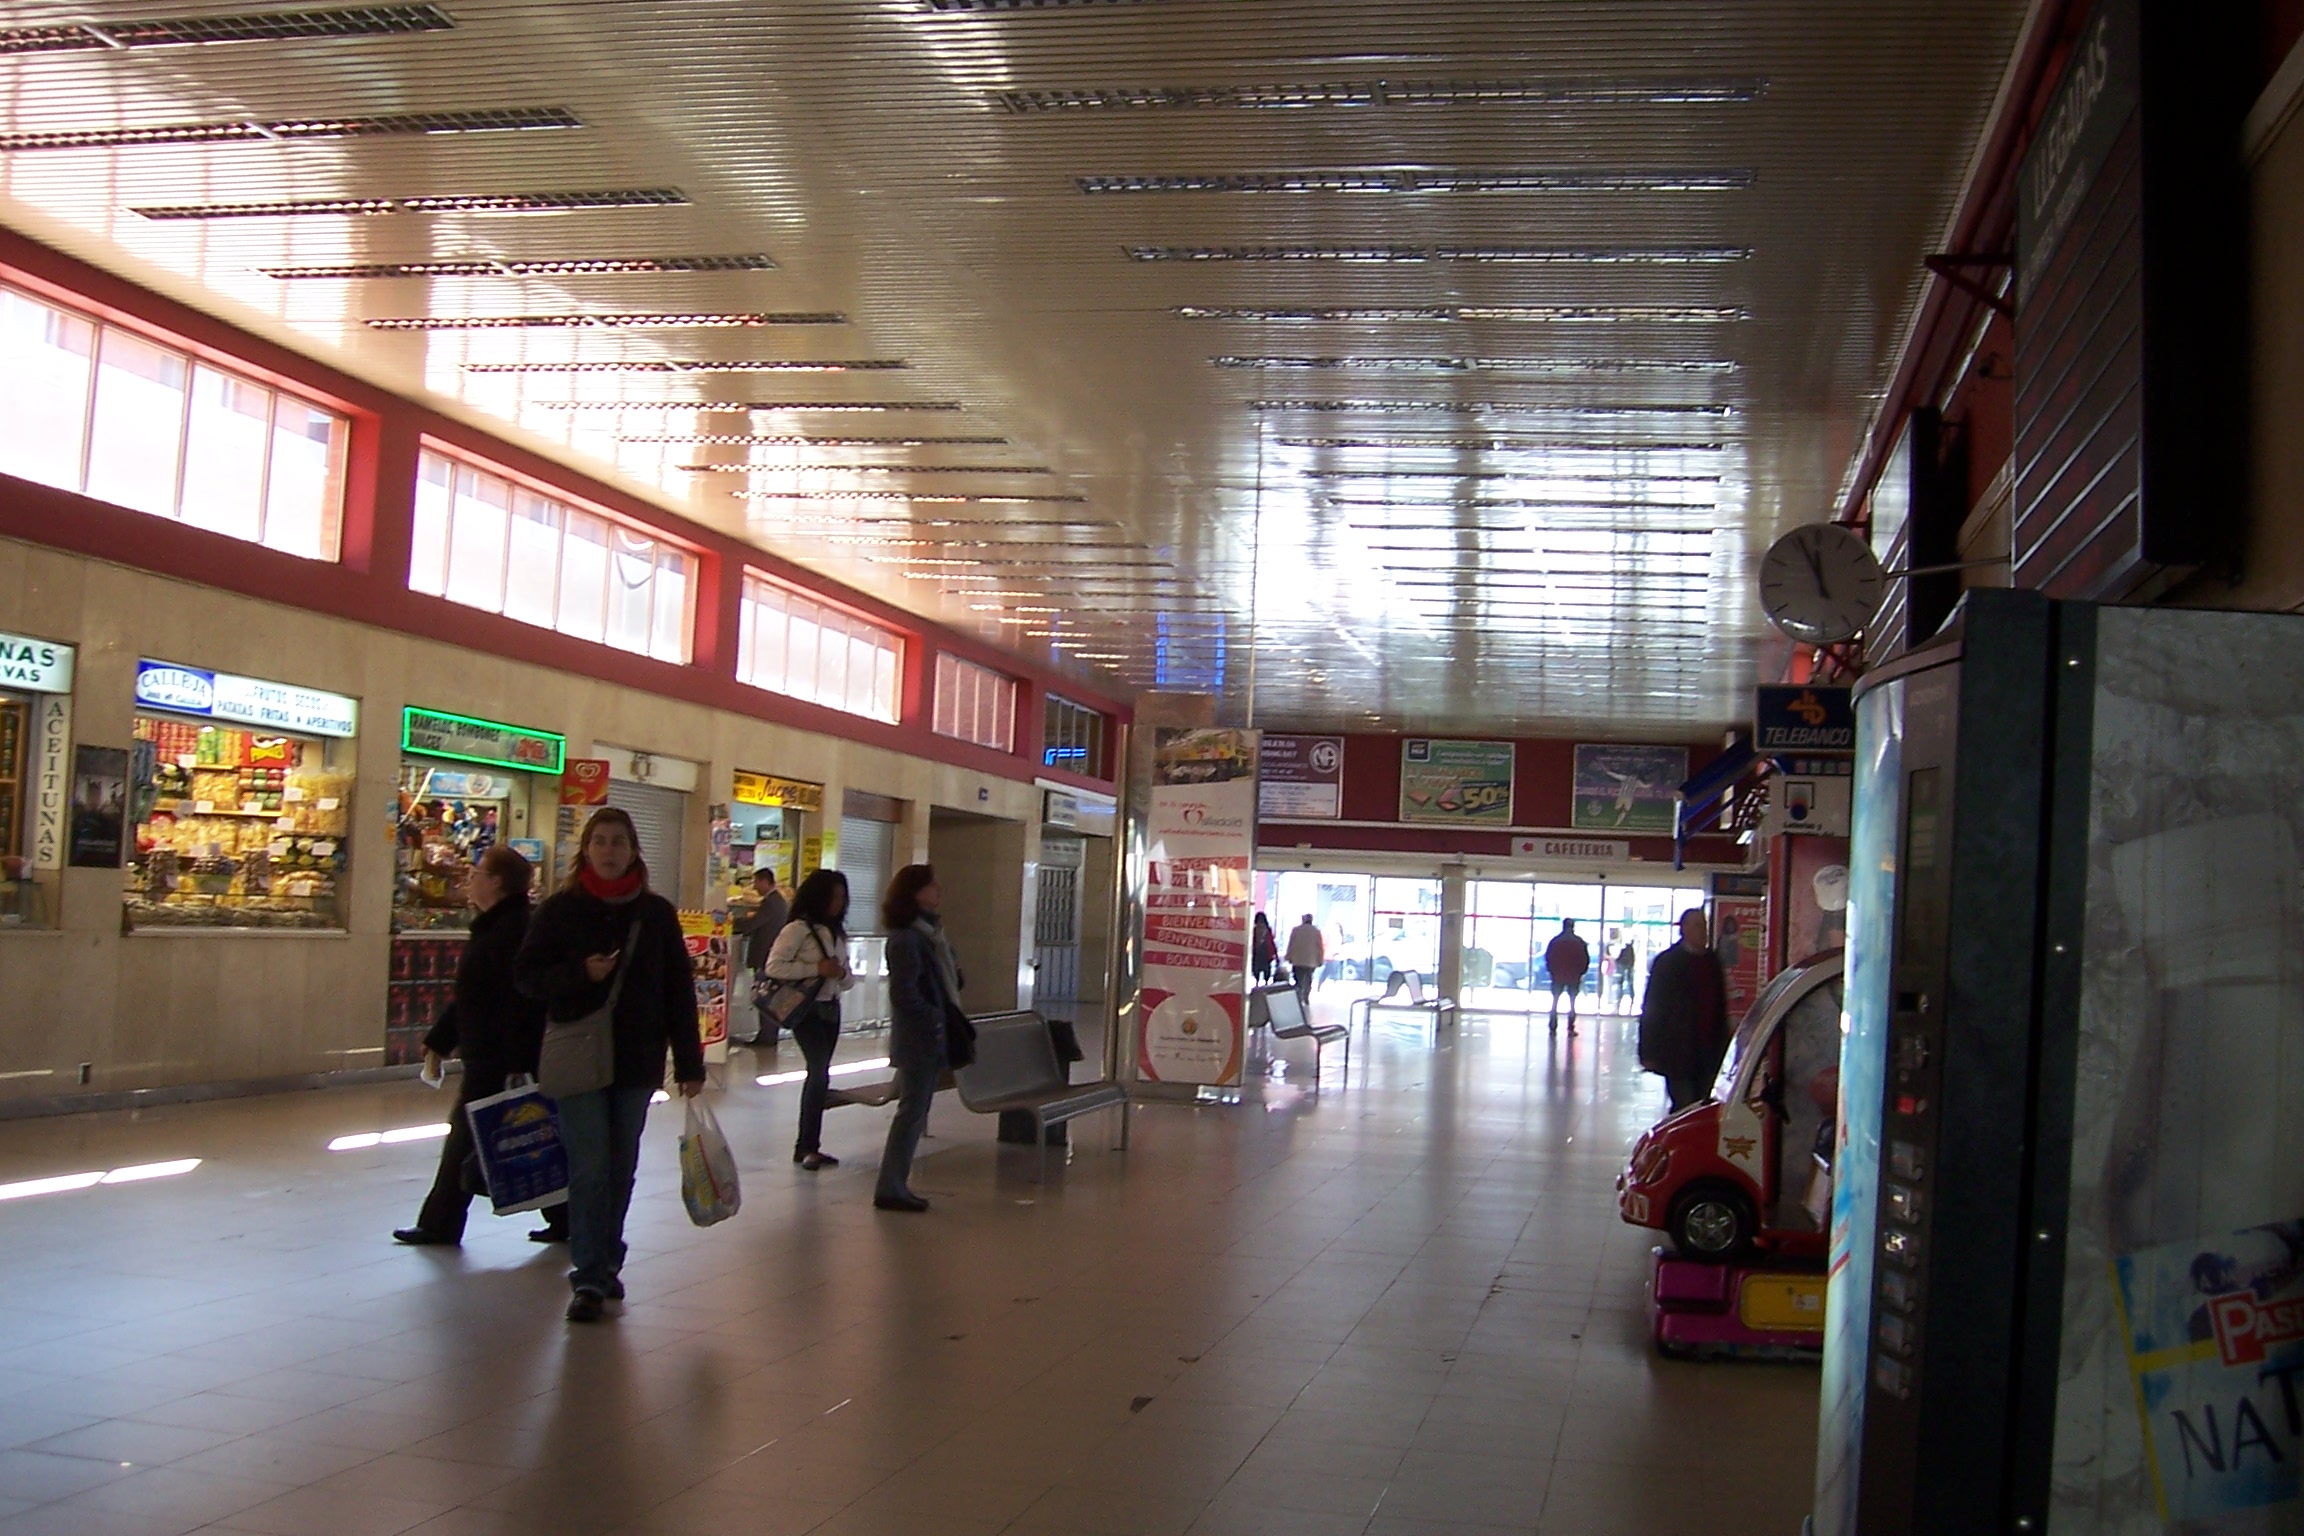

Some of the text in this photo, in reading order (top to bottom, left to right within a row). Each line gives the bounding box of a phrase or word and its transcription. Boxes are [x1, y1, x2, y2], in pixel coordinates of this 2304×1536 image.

[0, 642, 54, 667] NAS
[0, 665, 40, 682] VAS
[141, 670, 206, 697] CALLEJA
[260, 707, 289, 723] FRITAS
[1765, 727, 1851, 745] TELEBANCO
[38, 701, 63, 863] ACEITUNAS
[1157, 929, 1227, 953] BENVENUTO
[1166, 952, 1191, 966] BOA
[2170, 1364, 2304, 1478] NAT
